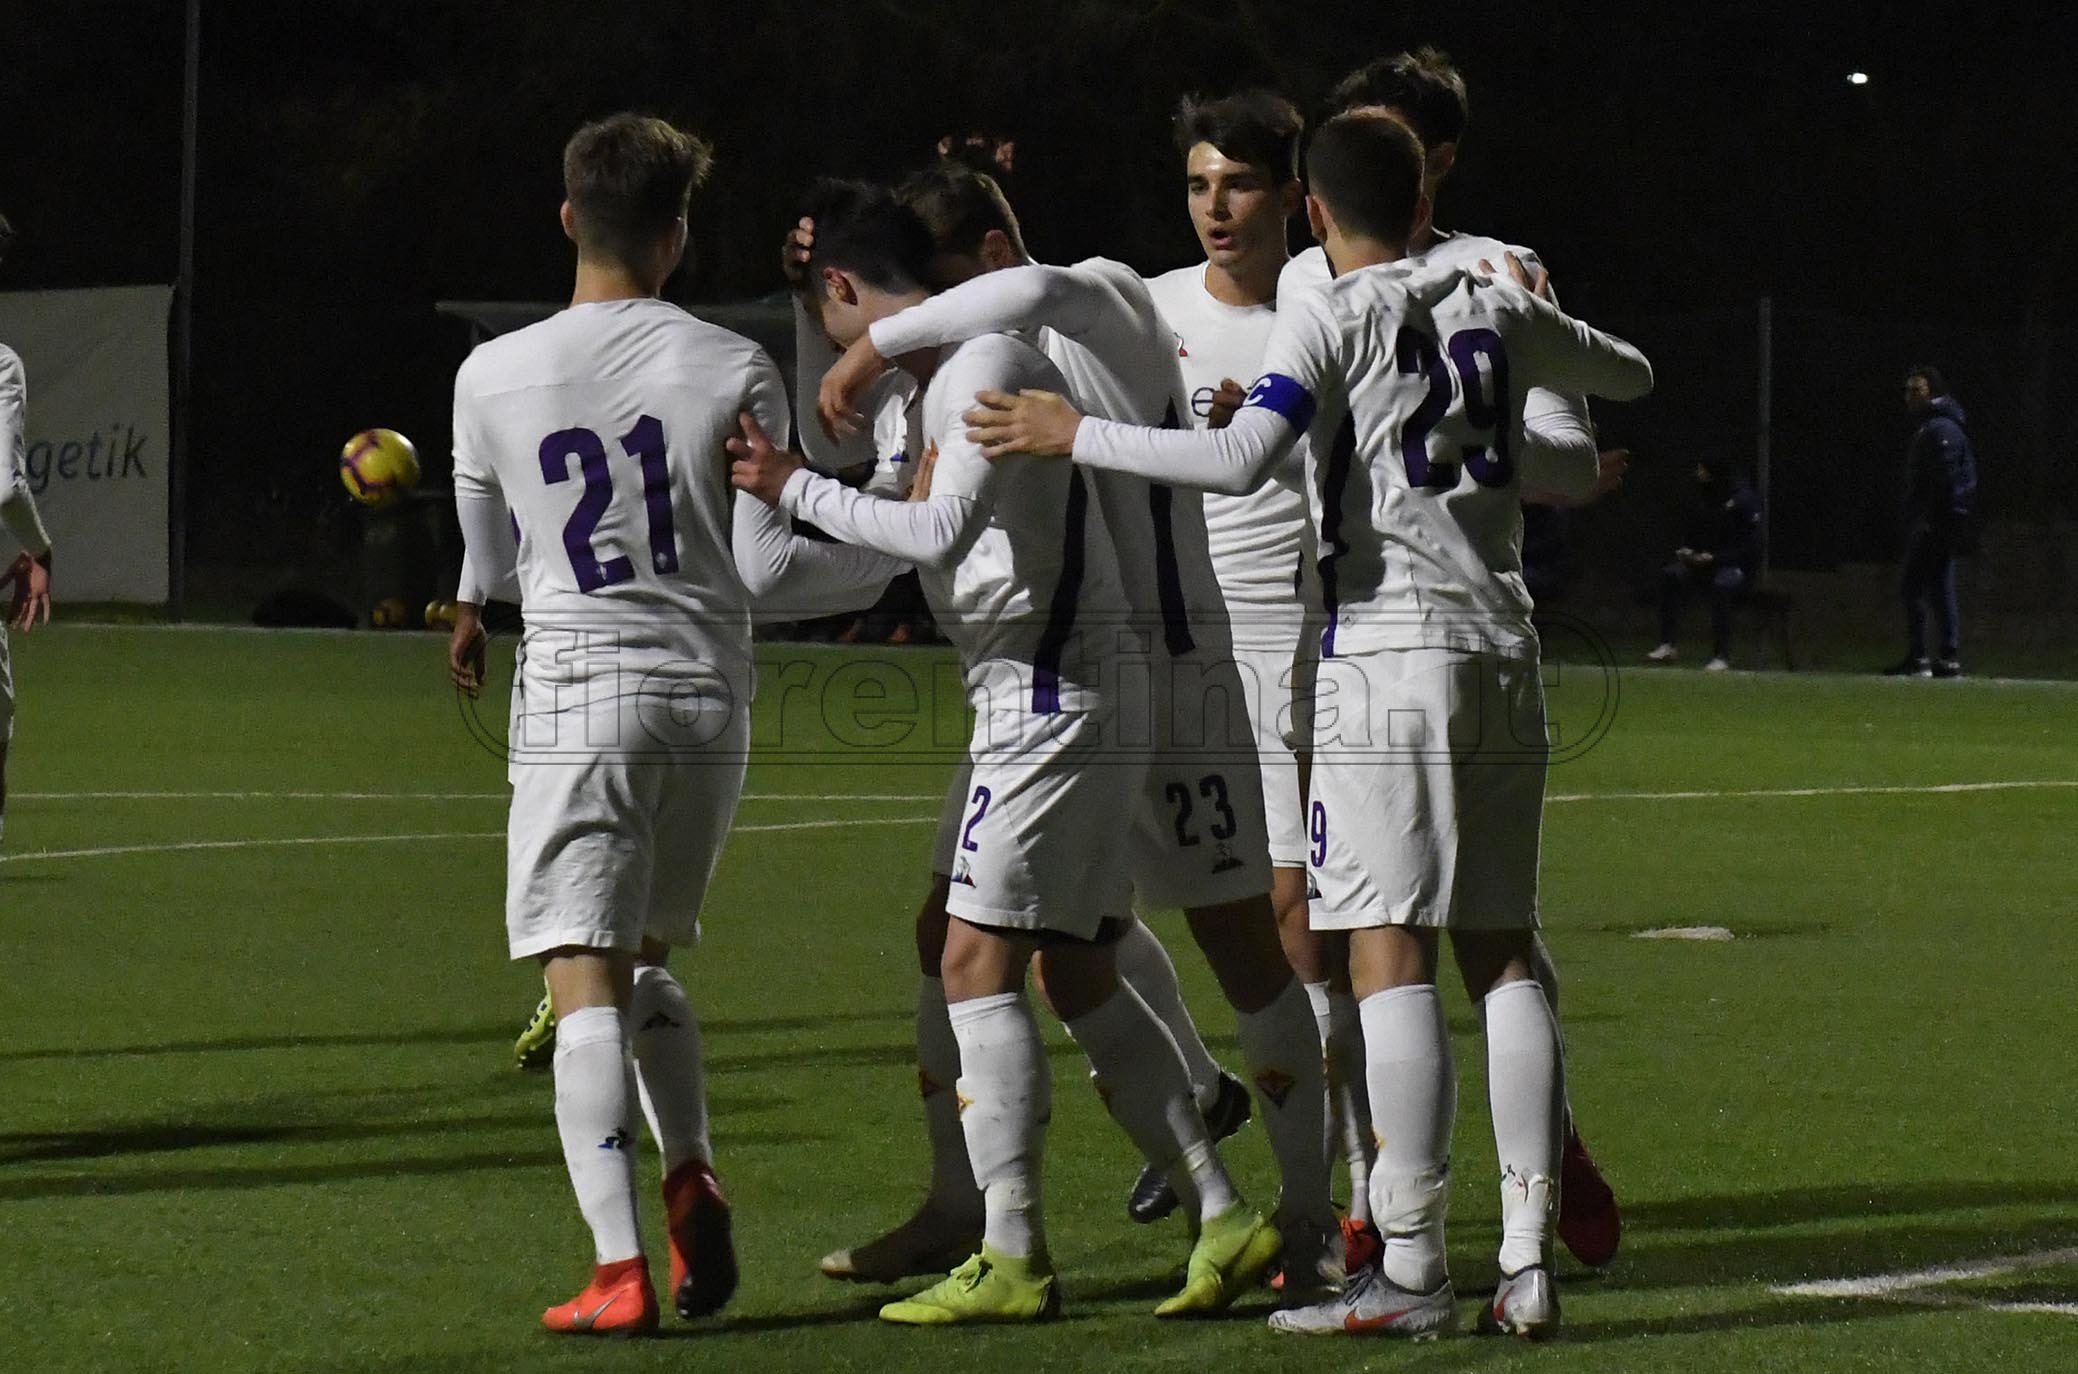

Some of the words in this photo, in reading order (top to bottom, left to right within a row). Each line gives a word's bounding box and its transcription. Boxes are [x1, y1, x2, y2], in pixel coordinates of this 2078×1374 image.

[1396, 326, 1511, 488] 29
[539, 414, 679, 593] 21
[962, 785, 991, 853] 2
[1166, 774, 1238, 847] 23
